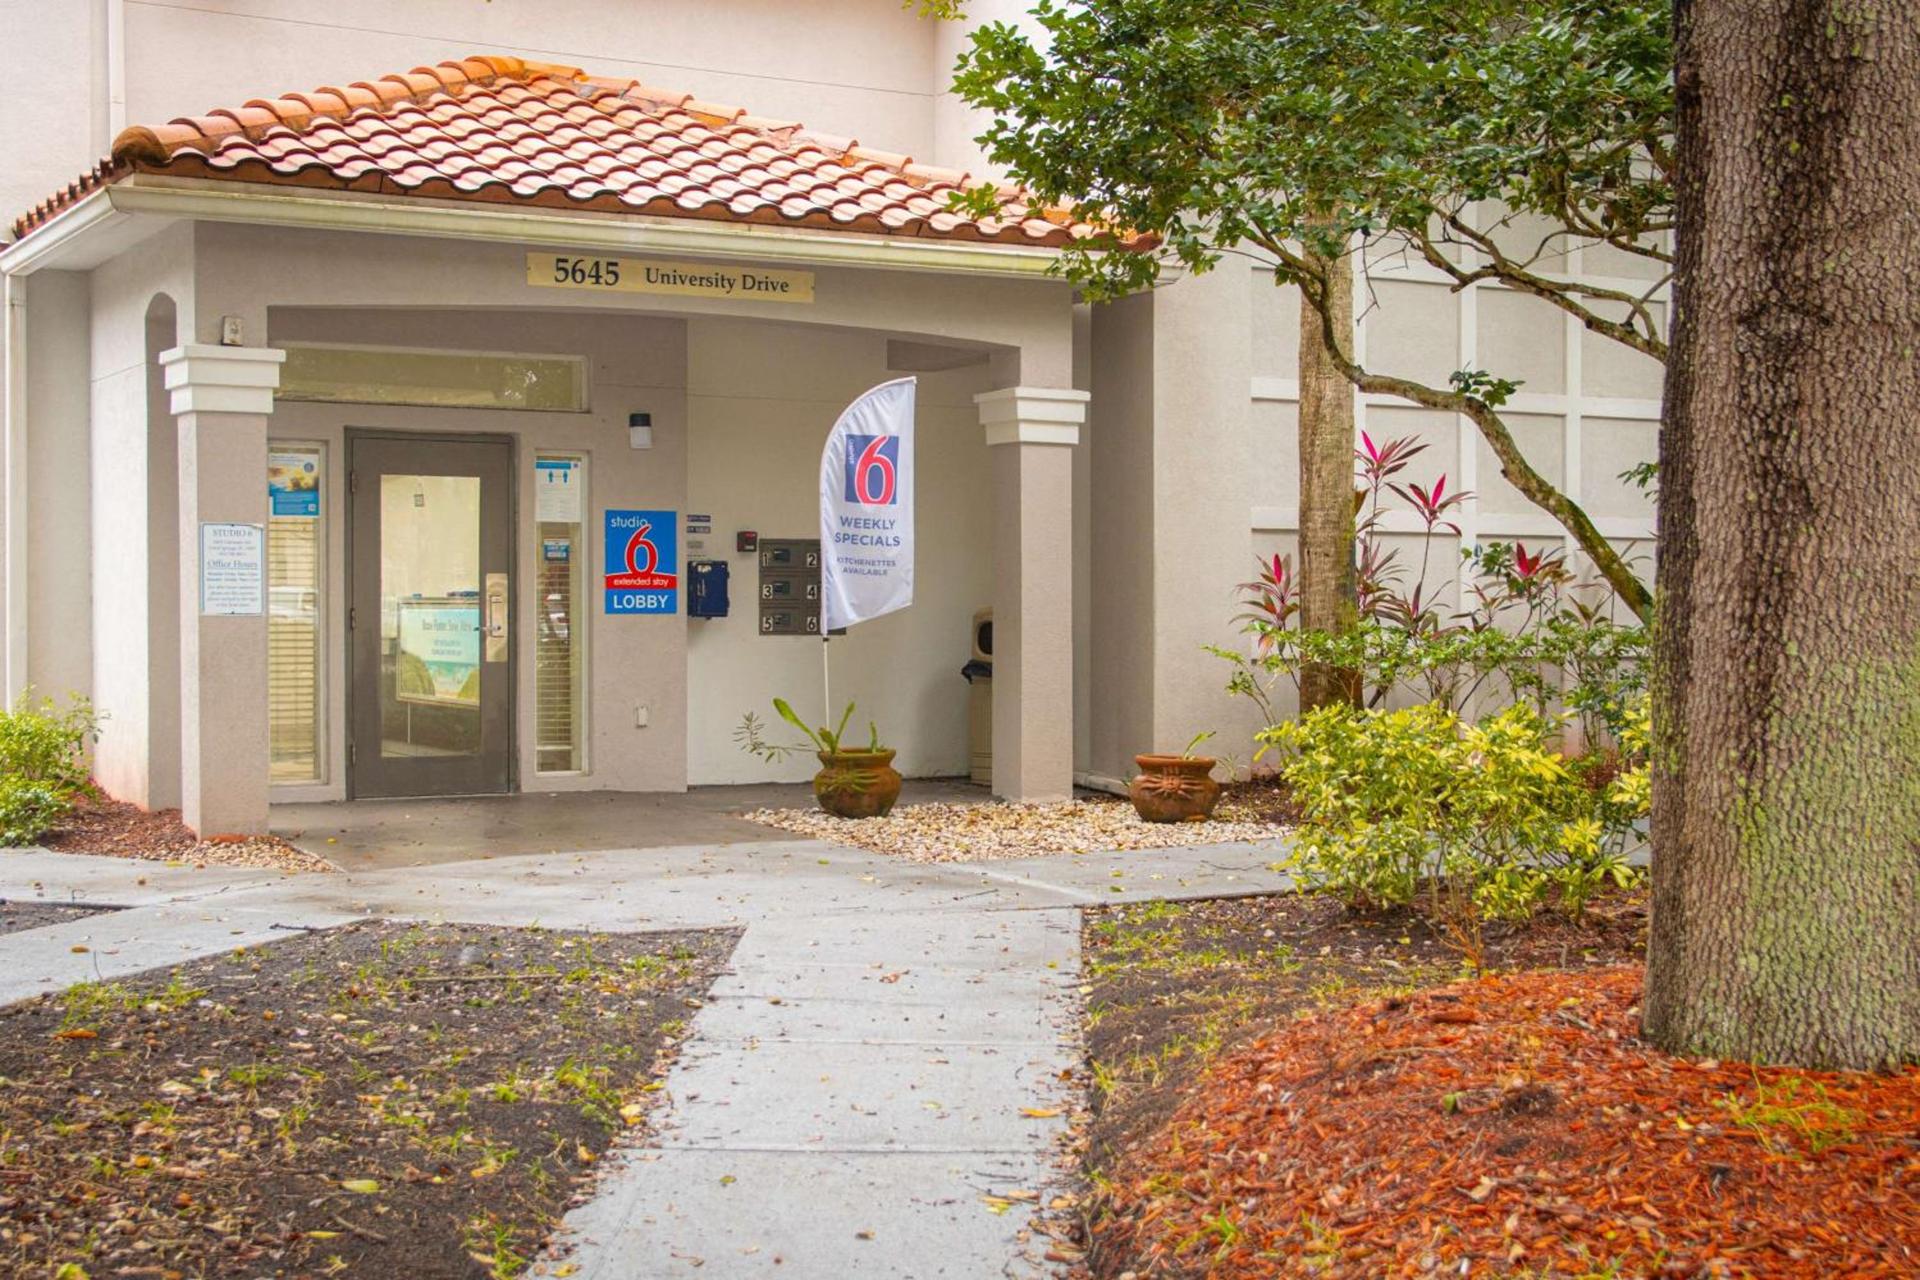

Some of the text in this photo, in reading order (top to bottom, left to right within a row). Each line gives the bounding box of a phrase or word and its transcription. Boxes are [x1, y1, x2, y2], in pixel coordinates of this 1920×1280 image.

[554, 257, 790, 294] 5645 University Drive
[854, 434, 896, 506] 6
[610, 516, 648, 528] studio
[840, 515, 896, 530] WEEKLY
[834, 532, 901, 547] SPECIALS
[624, 523, 659, 574] 6
[807, 553, 816, 567] 2
[837, 556, 896, 567] KITCHENETTES
[842, 567, 888, 576] AVAILABLE
[613, 577, 669, 587] extended stay
[763, 585, 773, 598] 3
[807, 585, 816, 599] 4
[613, 595, 668, 608] LOBBY
[763, 617, 773, 631] 5
[807, 617, 816, 631] 6
